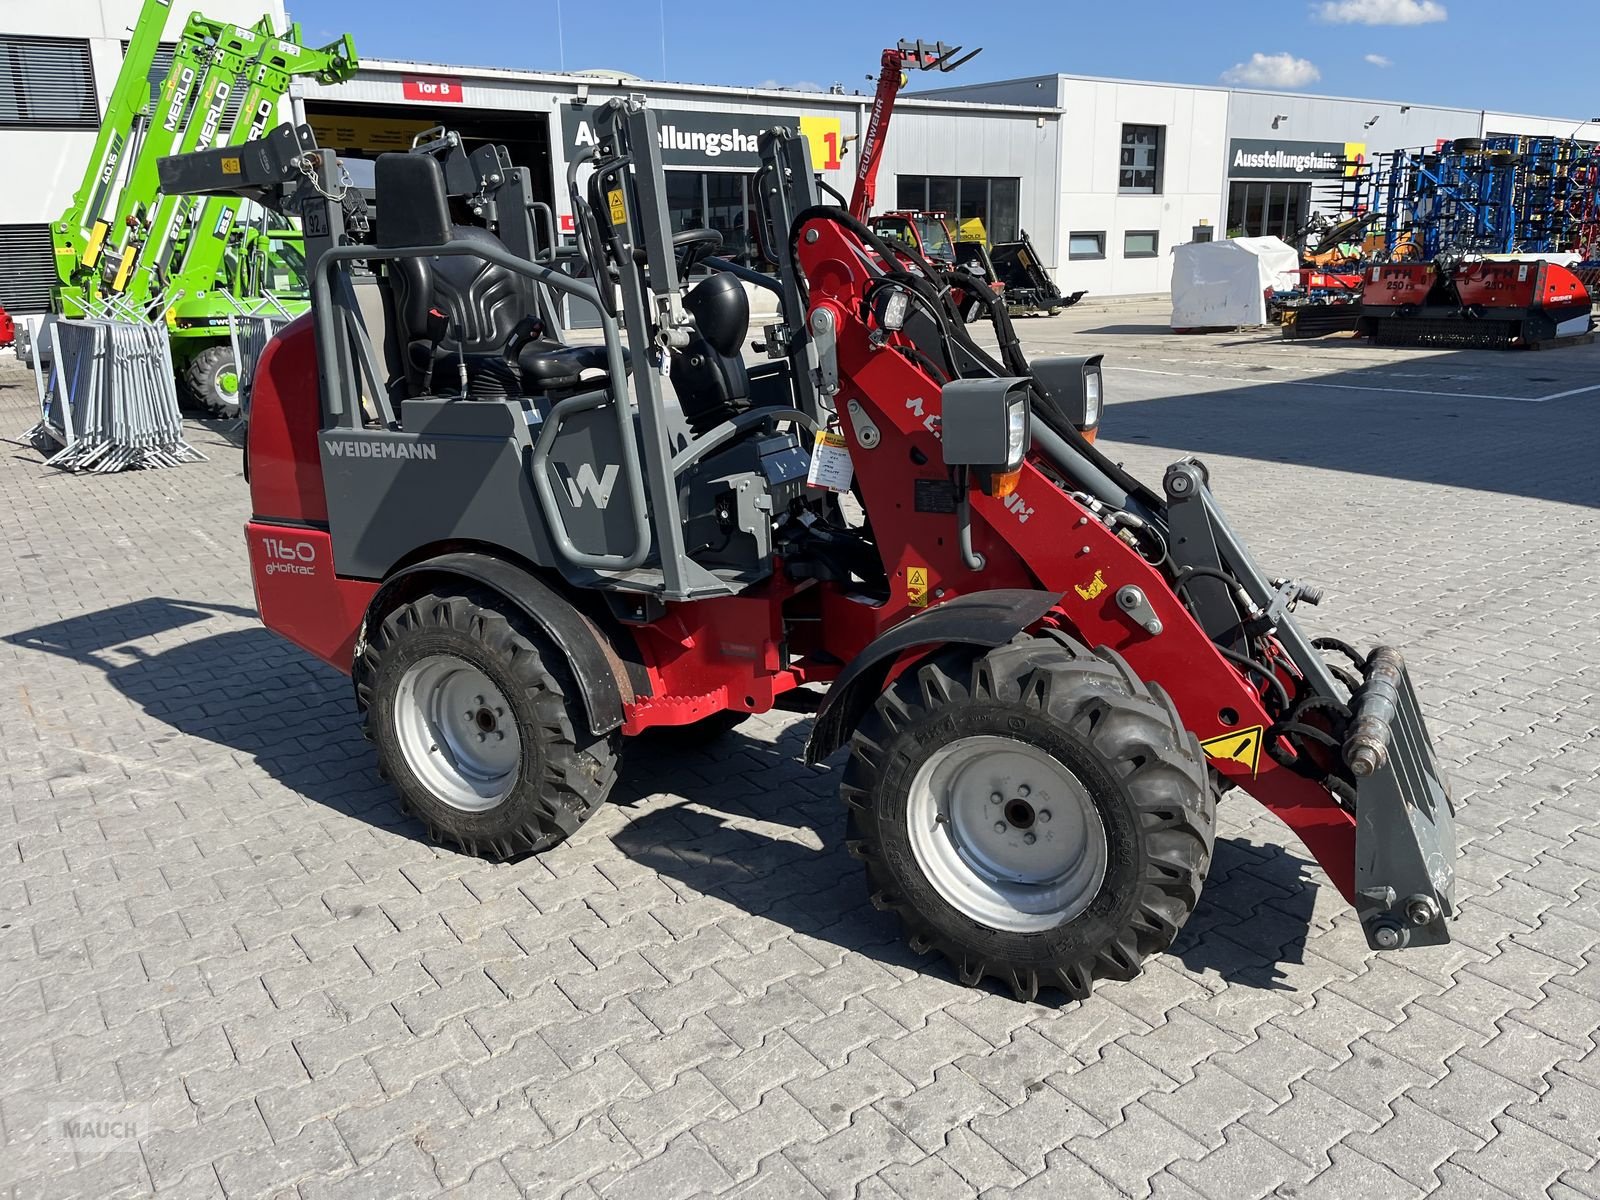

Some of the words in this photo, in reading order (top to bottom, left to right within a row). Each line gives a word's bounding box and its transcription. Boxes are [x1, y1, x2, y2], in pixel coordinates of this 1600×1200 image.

[416, 81, 437, 93] Tor
[440, 83, 450, 94] B
[163, 67, 194, 132] MERLO
[574, 121, 765, 155] Allungsha
[823, 132, 841, 169] 1
[859, 98, 884, 180] FEUERWEHR
[309, 214, 320, 233] 92
[1386, 281, 1404, 290] 250
[324, 440, 437, 460] WEIDEMANN
[262, 537, 315, 562] 1160
